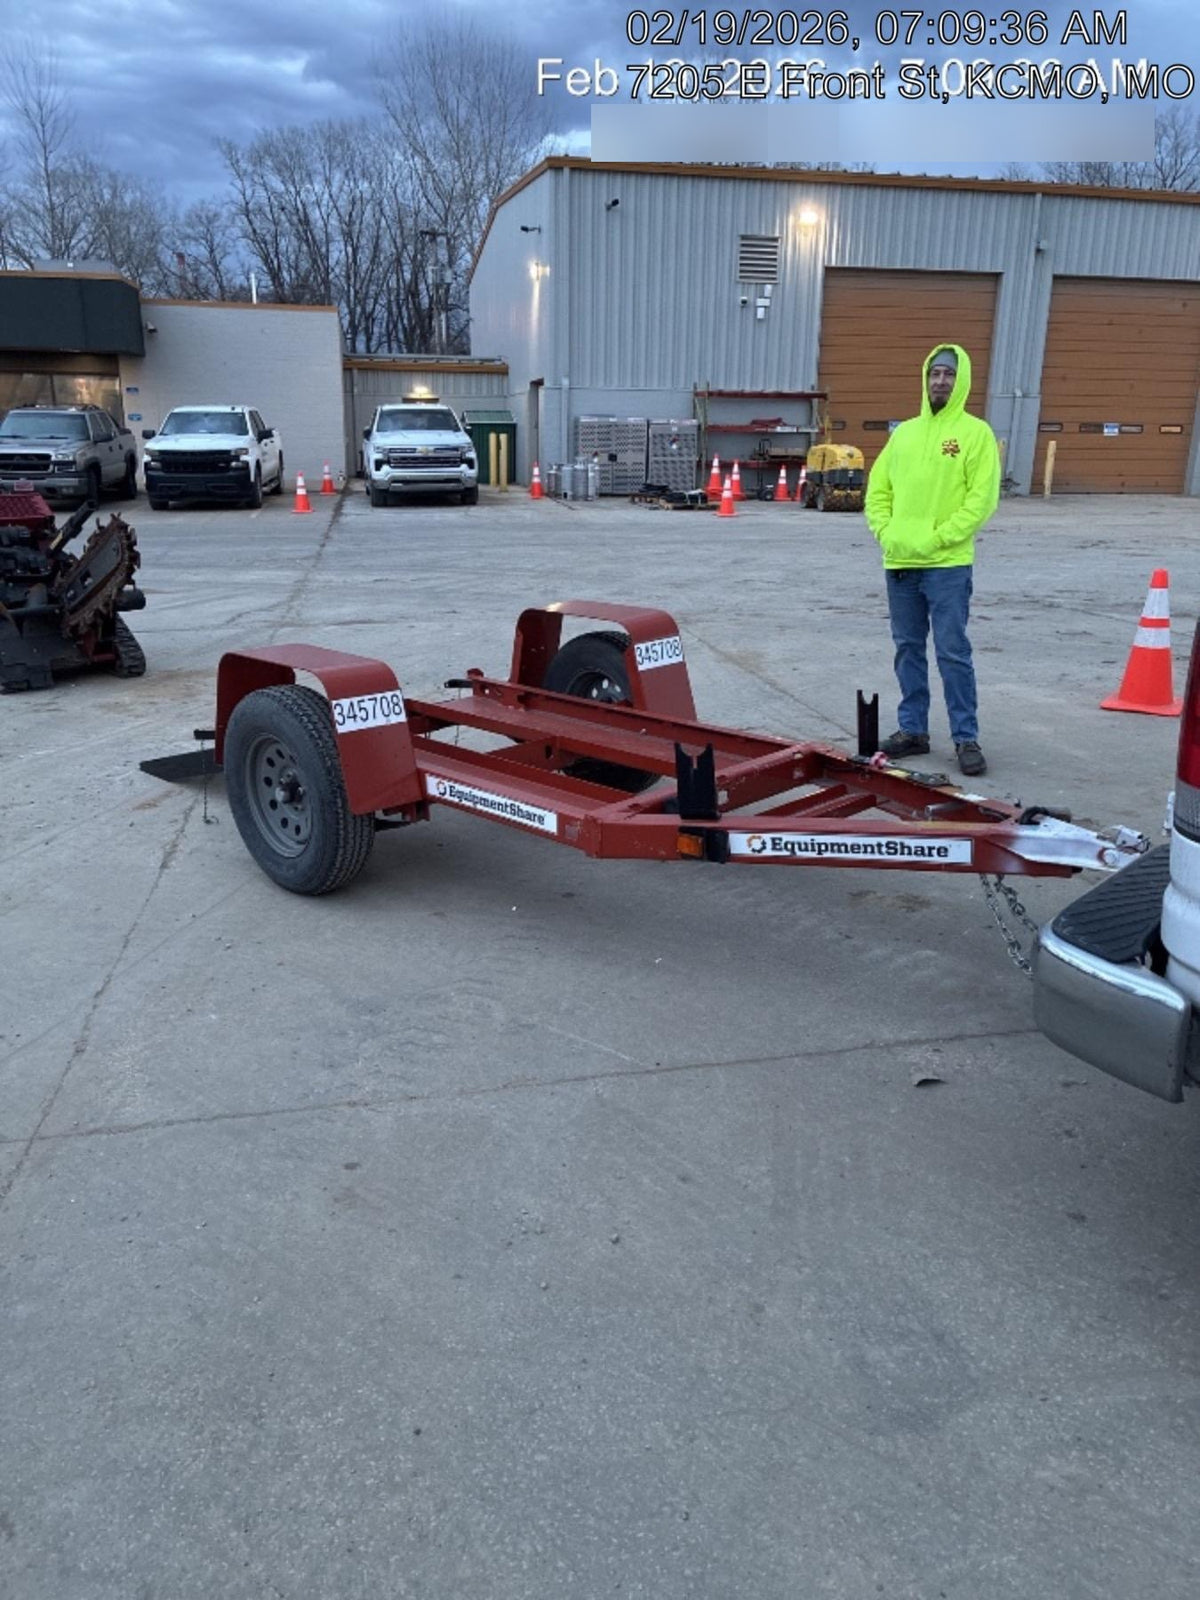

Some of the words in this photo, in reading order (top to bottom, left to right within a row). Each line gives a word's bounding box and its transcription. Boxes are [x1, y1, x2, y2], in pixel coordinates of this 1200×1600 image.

[635, 638, 681, 666] 345708
[333, 693, 403, 726] 345708
[448, 784, 546, 826] EquipmentShare
[770, 836, 949, 858] EquipmentShare
